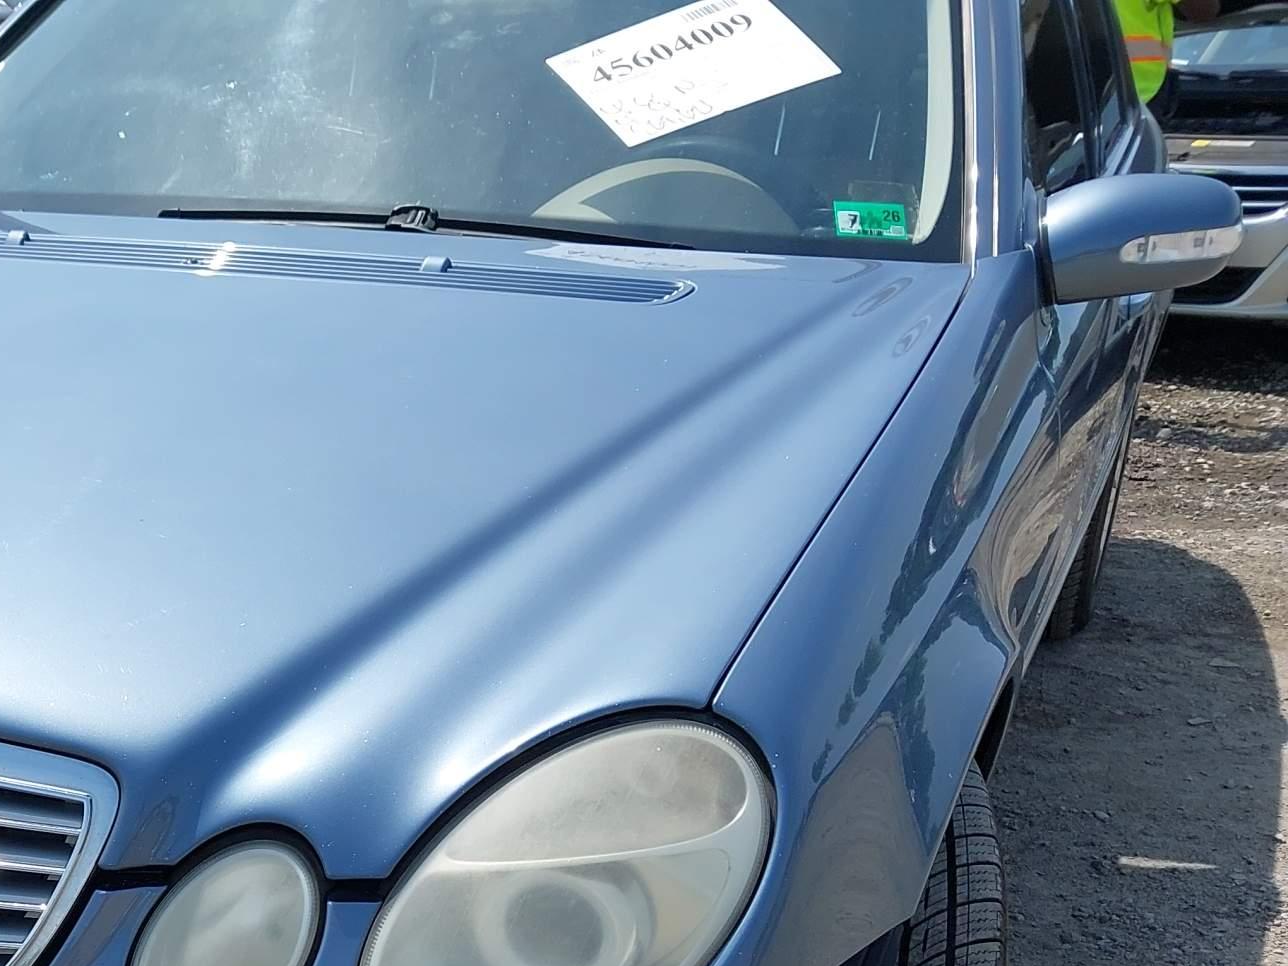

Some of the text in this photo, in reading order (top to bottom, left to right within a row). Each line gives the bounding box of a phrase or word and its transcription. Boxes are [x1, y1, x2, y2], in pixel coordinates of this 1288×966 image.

[592, 13, 753, 84] 45604009
[848, 210, 901, 228] 7 26
